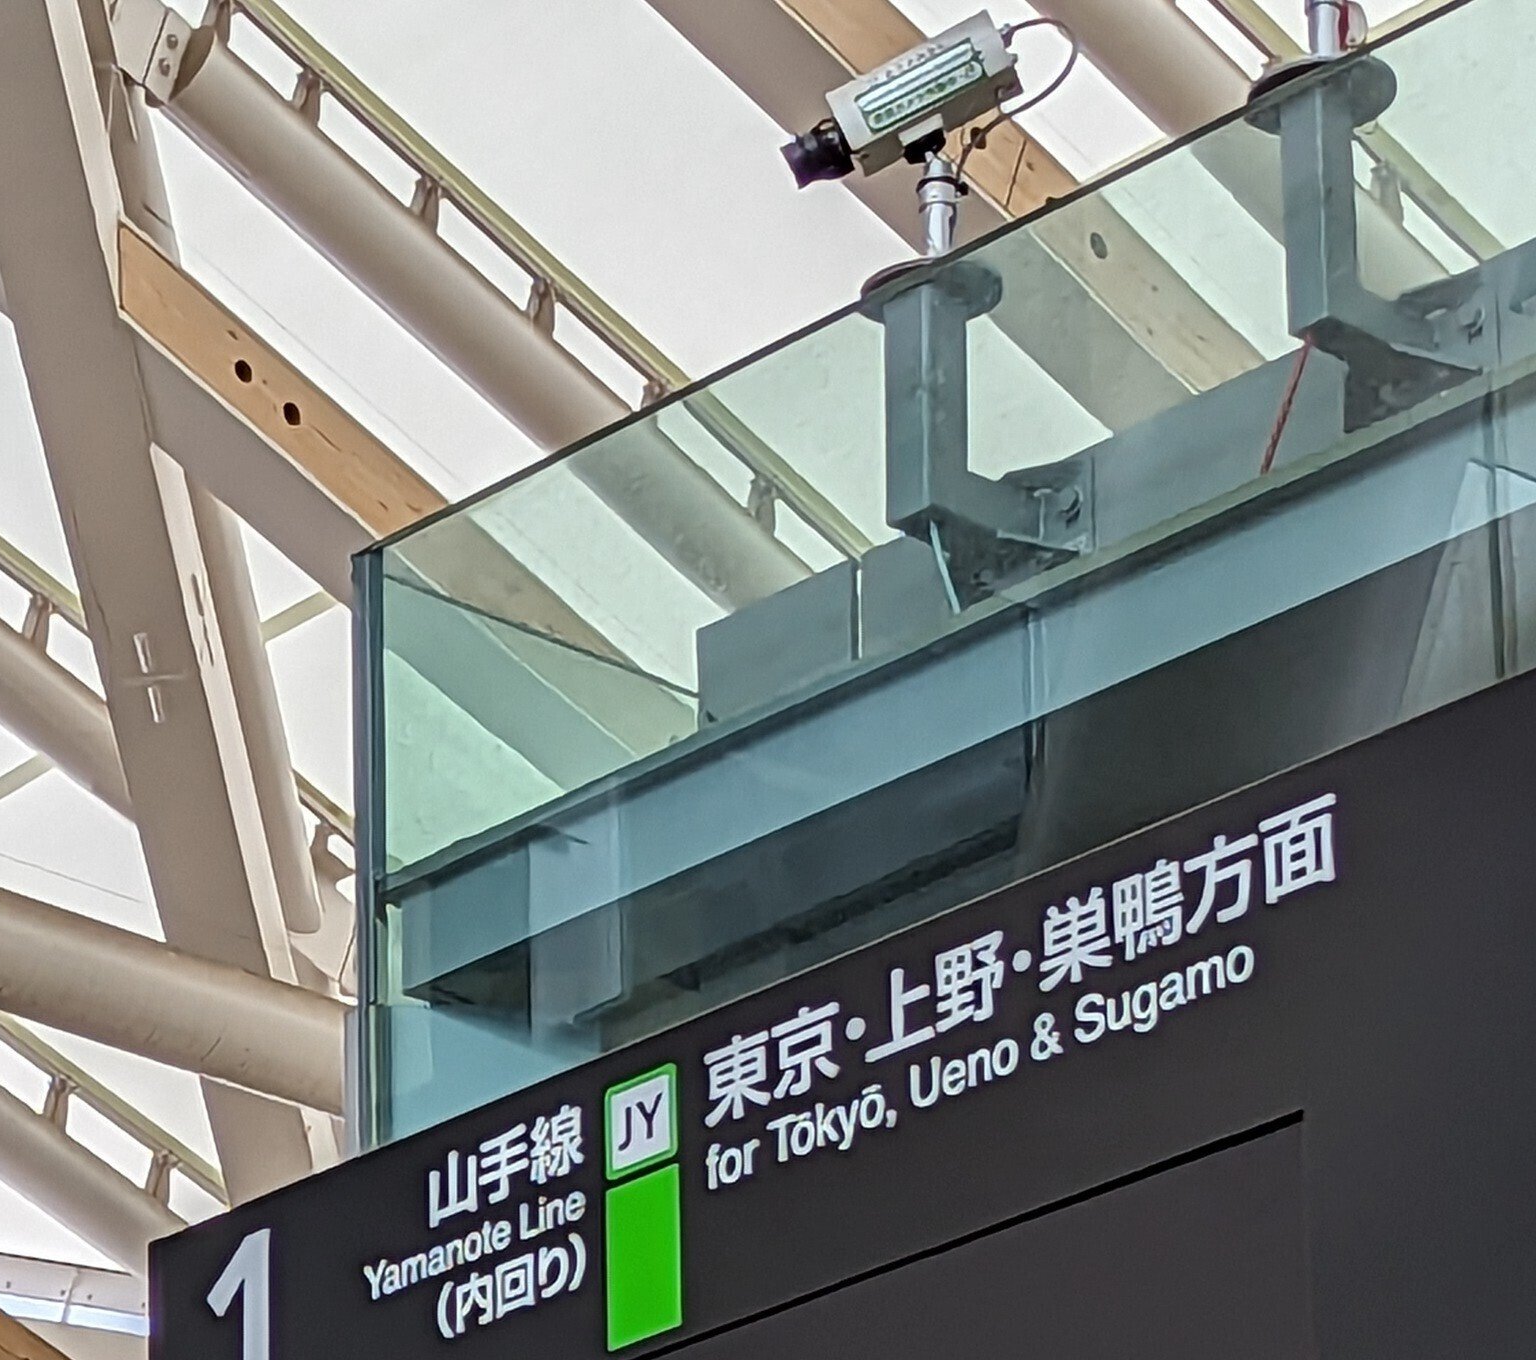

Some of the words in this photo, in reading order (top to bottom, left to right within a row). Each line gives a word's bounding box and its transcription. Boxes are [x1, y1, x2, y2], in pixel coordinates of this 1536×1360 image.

[704, 793, 1336, 1127] 東京・上野・巣鴨方面
[617, 1091, 664, 1152] JY
[707, 1139, 759, 1188] for
[910, 1037, 1018, 1107] Ueno
[1031, 1013, 1064, 1060] &
[1074, 945, 1254, 1043] Sugamo
[428, 1104, 585, 1228] 山手線
[364, 1221, 511, 1300] Yamanote
[520, 1190, 586, 1241] Line
[437, 1233, 587, 1339] (内回り)
